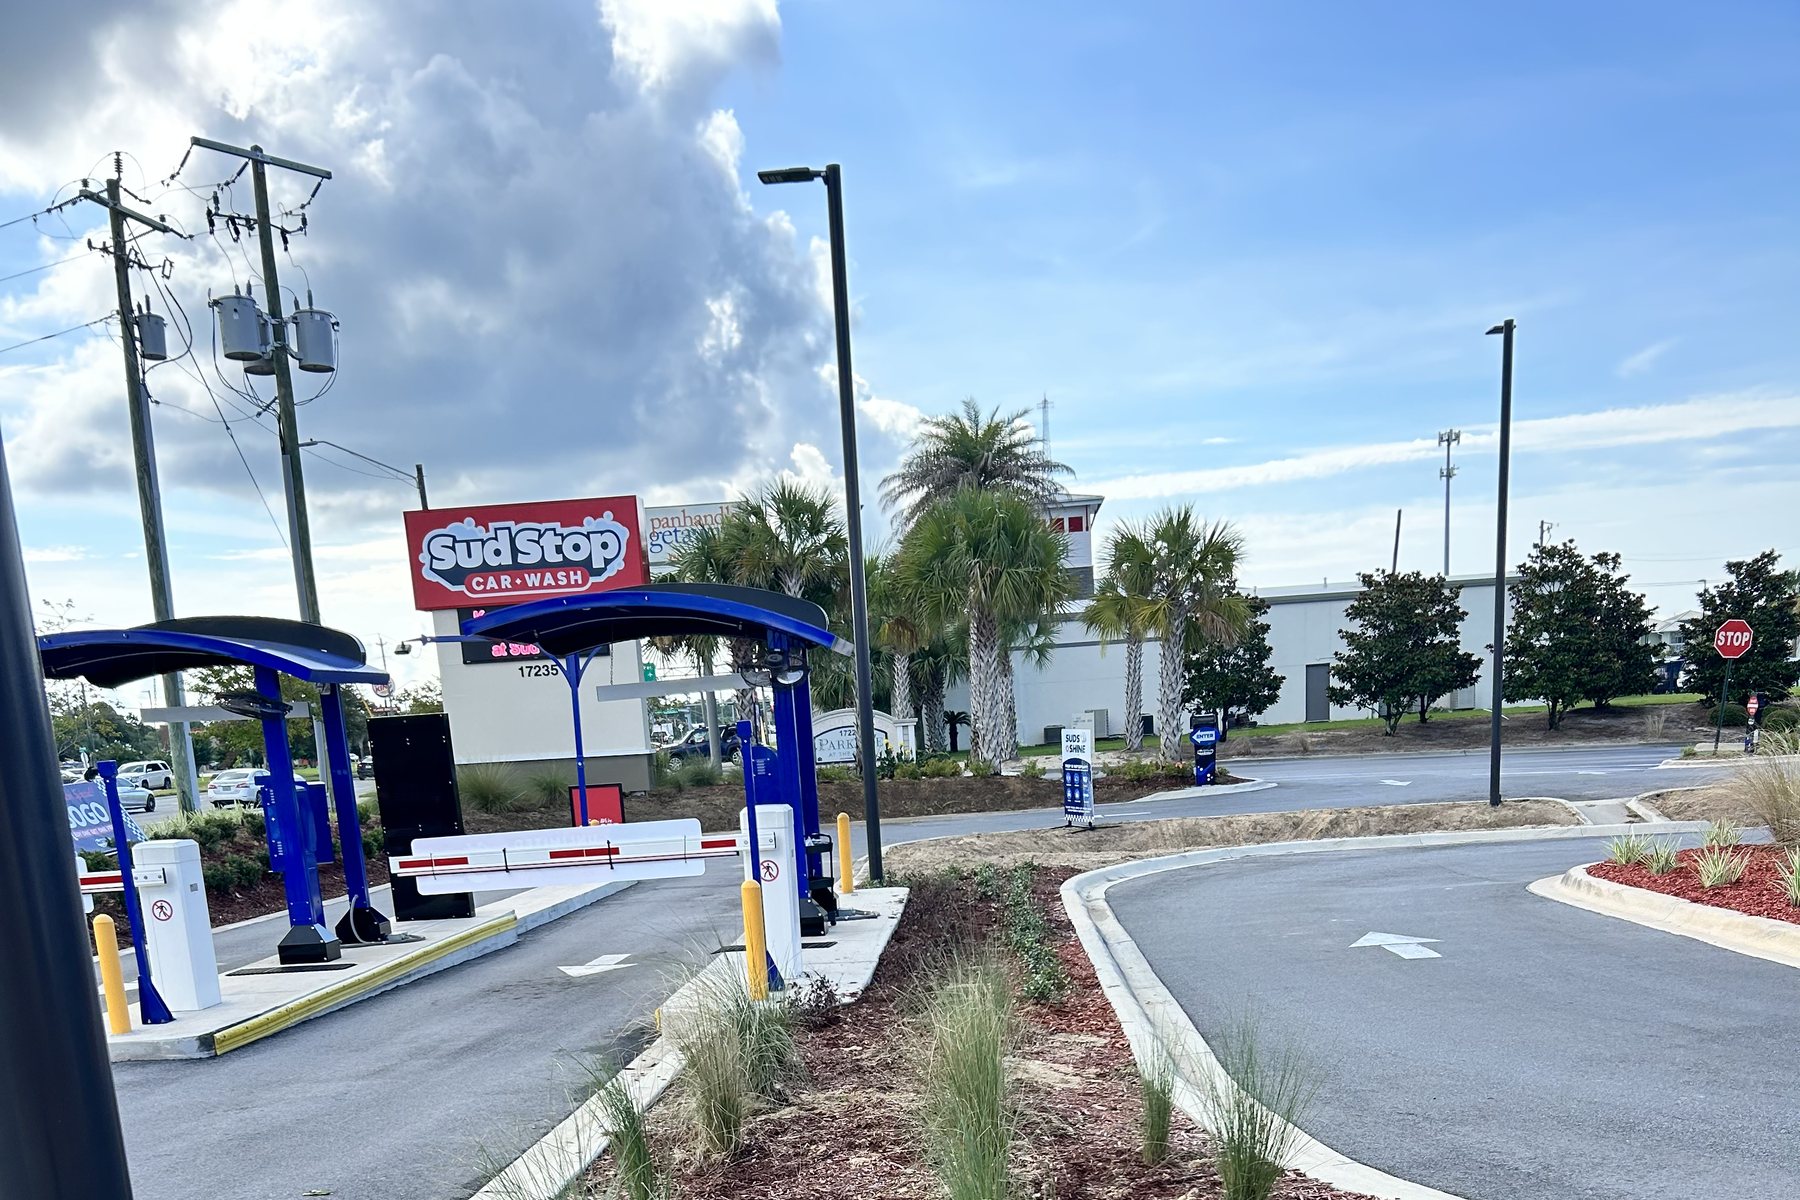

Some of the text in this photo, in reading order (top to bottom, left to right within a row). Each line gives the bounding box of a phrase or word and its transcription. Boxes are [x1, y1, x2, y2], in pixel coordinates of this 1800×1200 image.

[472, 570, 583, 591] CAR WASH
[1717, 631, 1750, 647] STOP
[491, 642, 508, 657] at
[518, 664, 559, 678] 17235
[1065, 734, 1080, 743] SUDS
